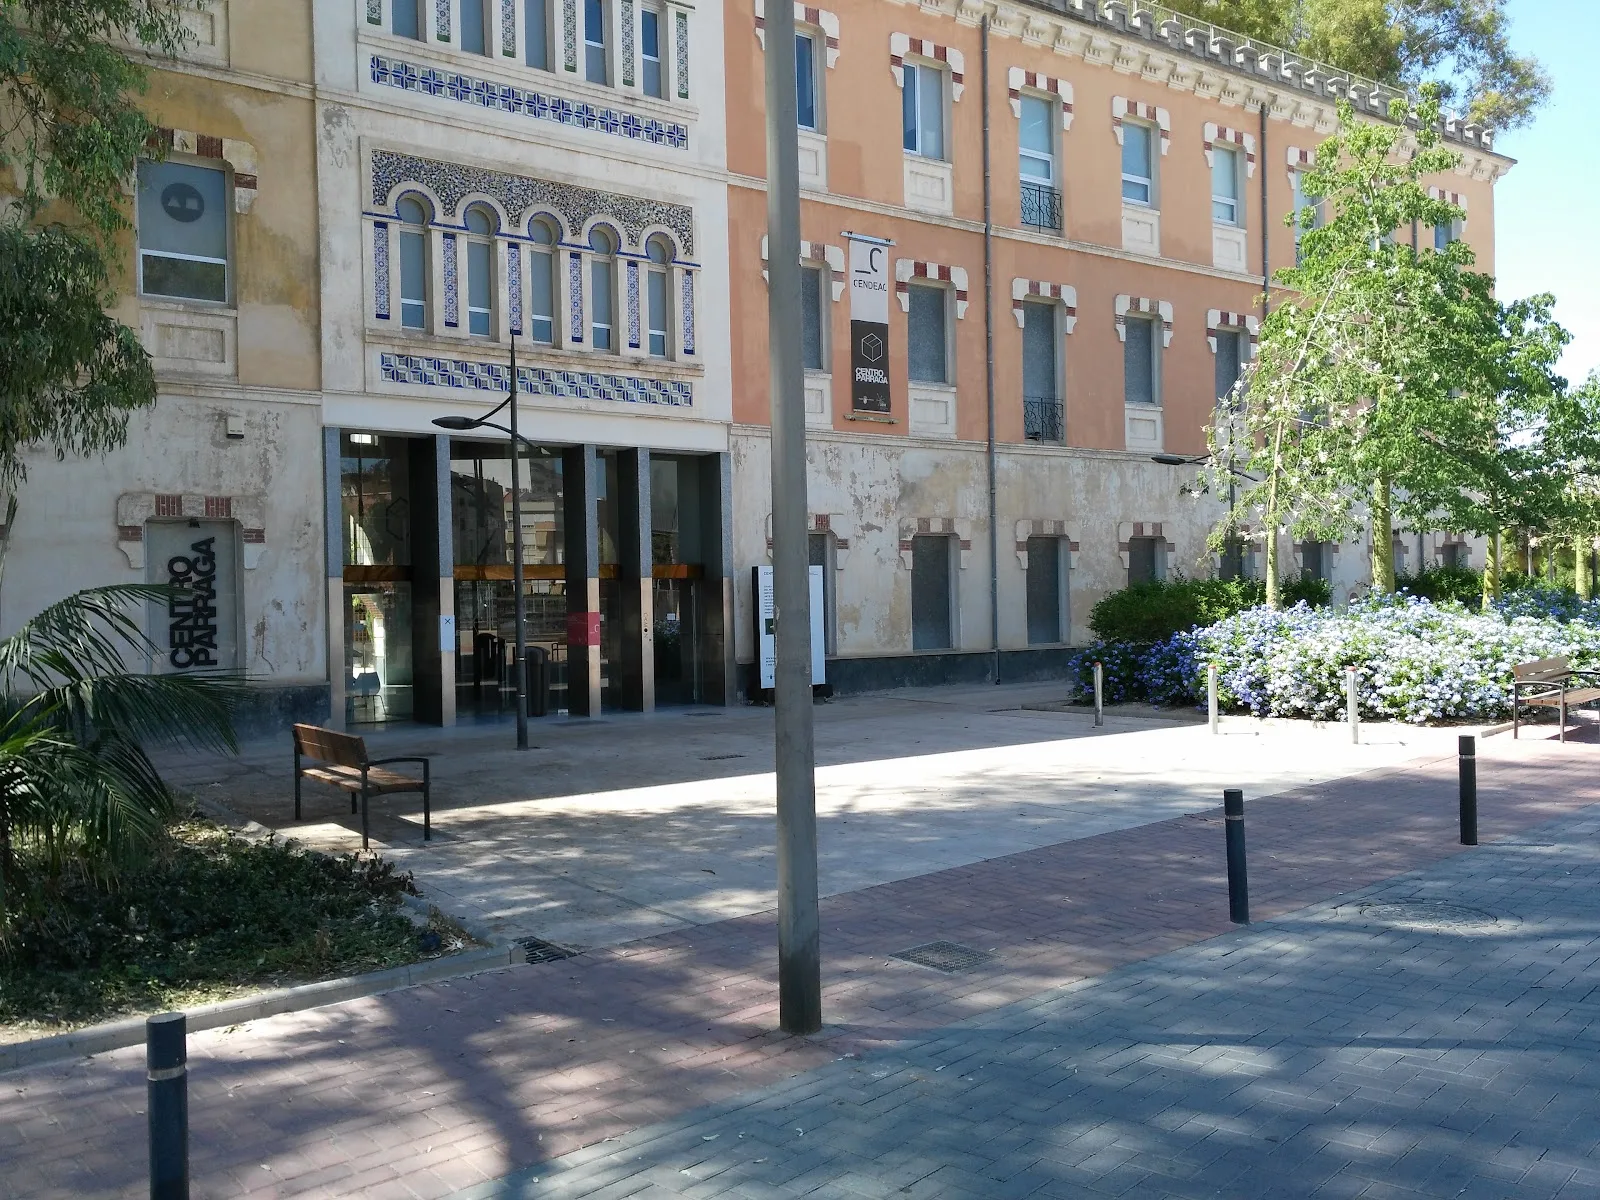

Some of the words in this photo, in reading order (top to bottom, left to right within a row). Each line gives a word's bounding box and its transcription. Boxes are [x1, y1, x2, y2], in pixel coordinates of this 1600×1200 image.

[853, 279, 887, 292] CENDEAC
[855, 367, 884, 377] CENTRO
[855, 374, 888, 385] PARRAGA
[191, 536, 218, 666] PARRAGA
[168, 556, 195, 668] CENTRO
